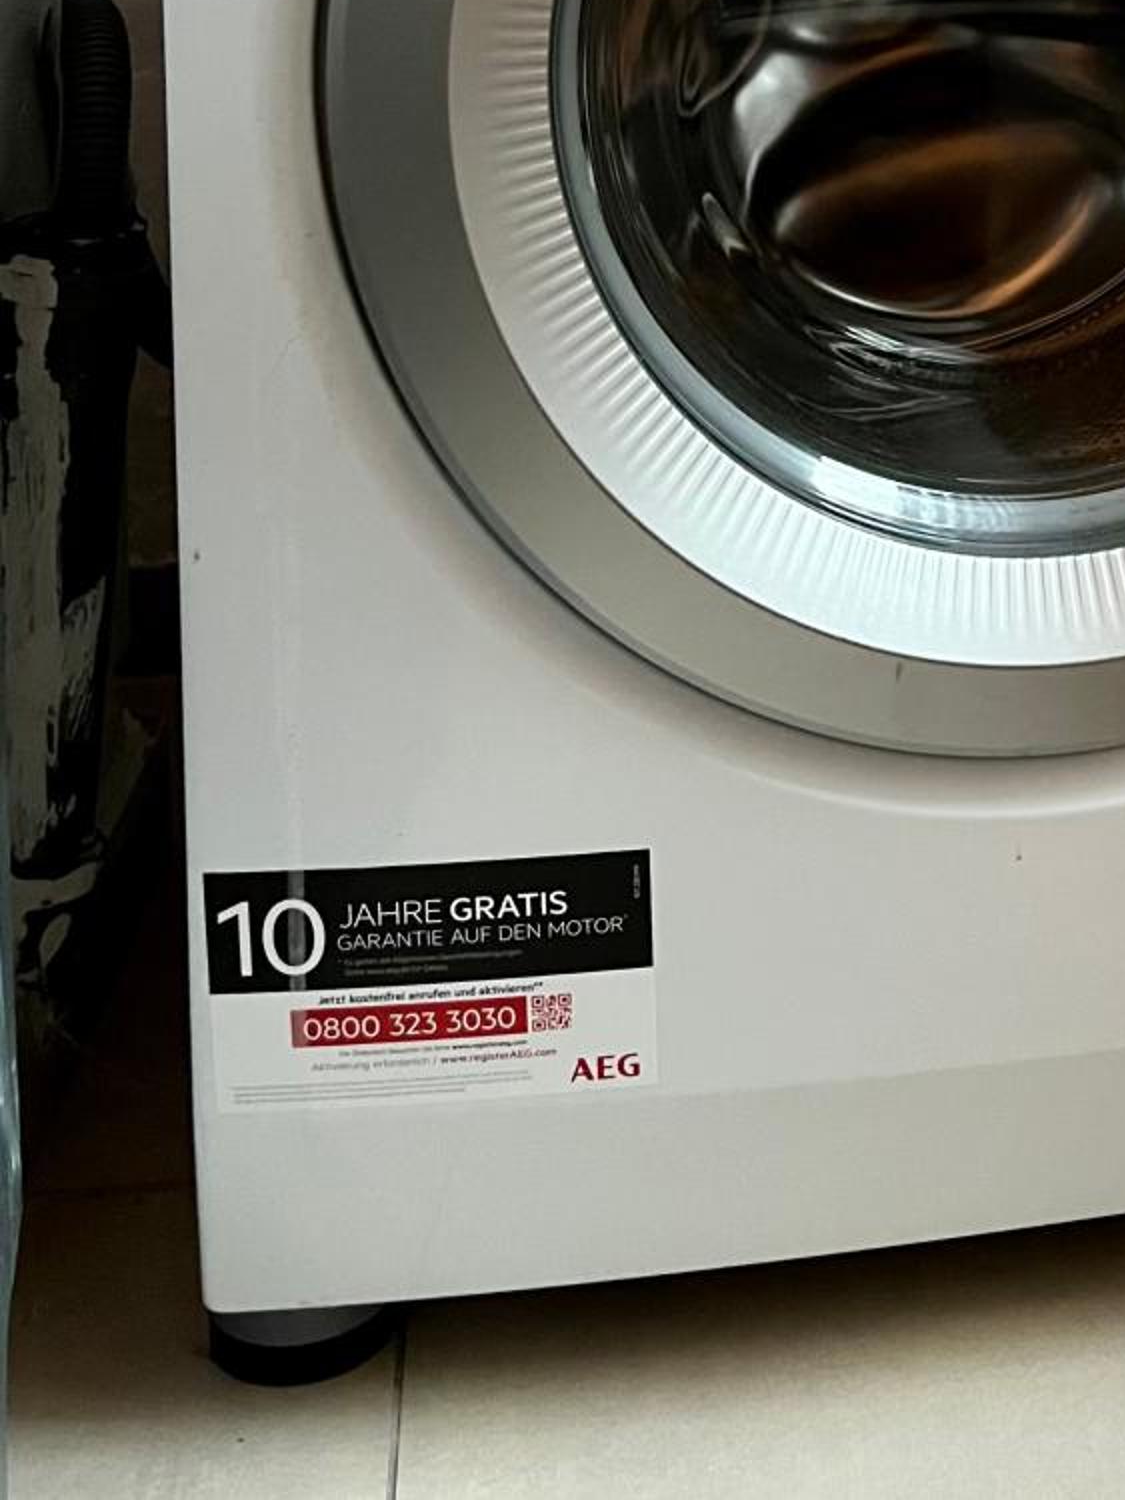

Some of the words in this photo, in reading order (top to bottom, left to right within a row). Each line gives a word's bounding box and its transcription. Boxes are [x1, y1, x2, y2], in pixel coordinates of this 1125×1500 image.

[216, 897, 326, 977] 10
[340, 899, 443, 929] JAHRE
[450, 890, 568, 922] GRATIS
[337, 928, 444, 951] GARANTIE
[450, 926, 492, 945] AUF
[498, 923, 541, 941] DEN
[349, 991, 406, 1004] kostenfrei
[409, 988, 451, 1000] anrufen
[453, 986, 476, 997] und
[303, 1014, 381, 1041] 0800
[389, 1011, 438, 1036] 323
[446, 1006, 517, 1033] 3030
[570, 1053, 642, 1084] AEG
